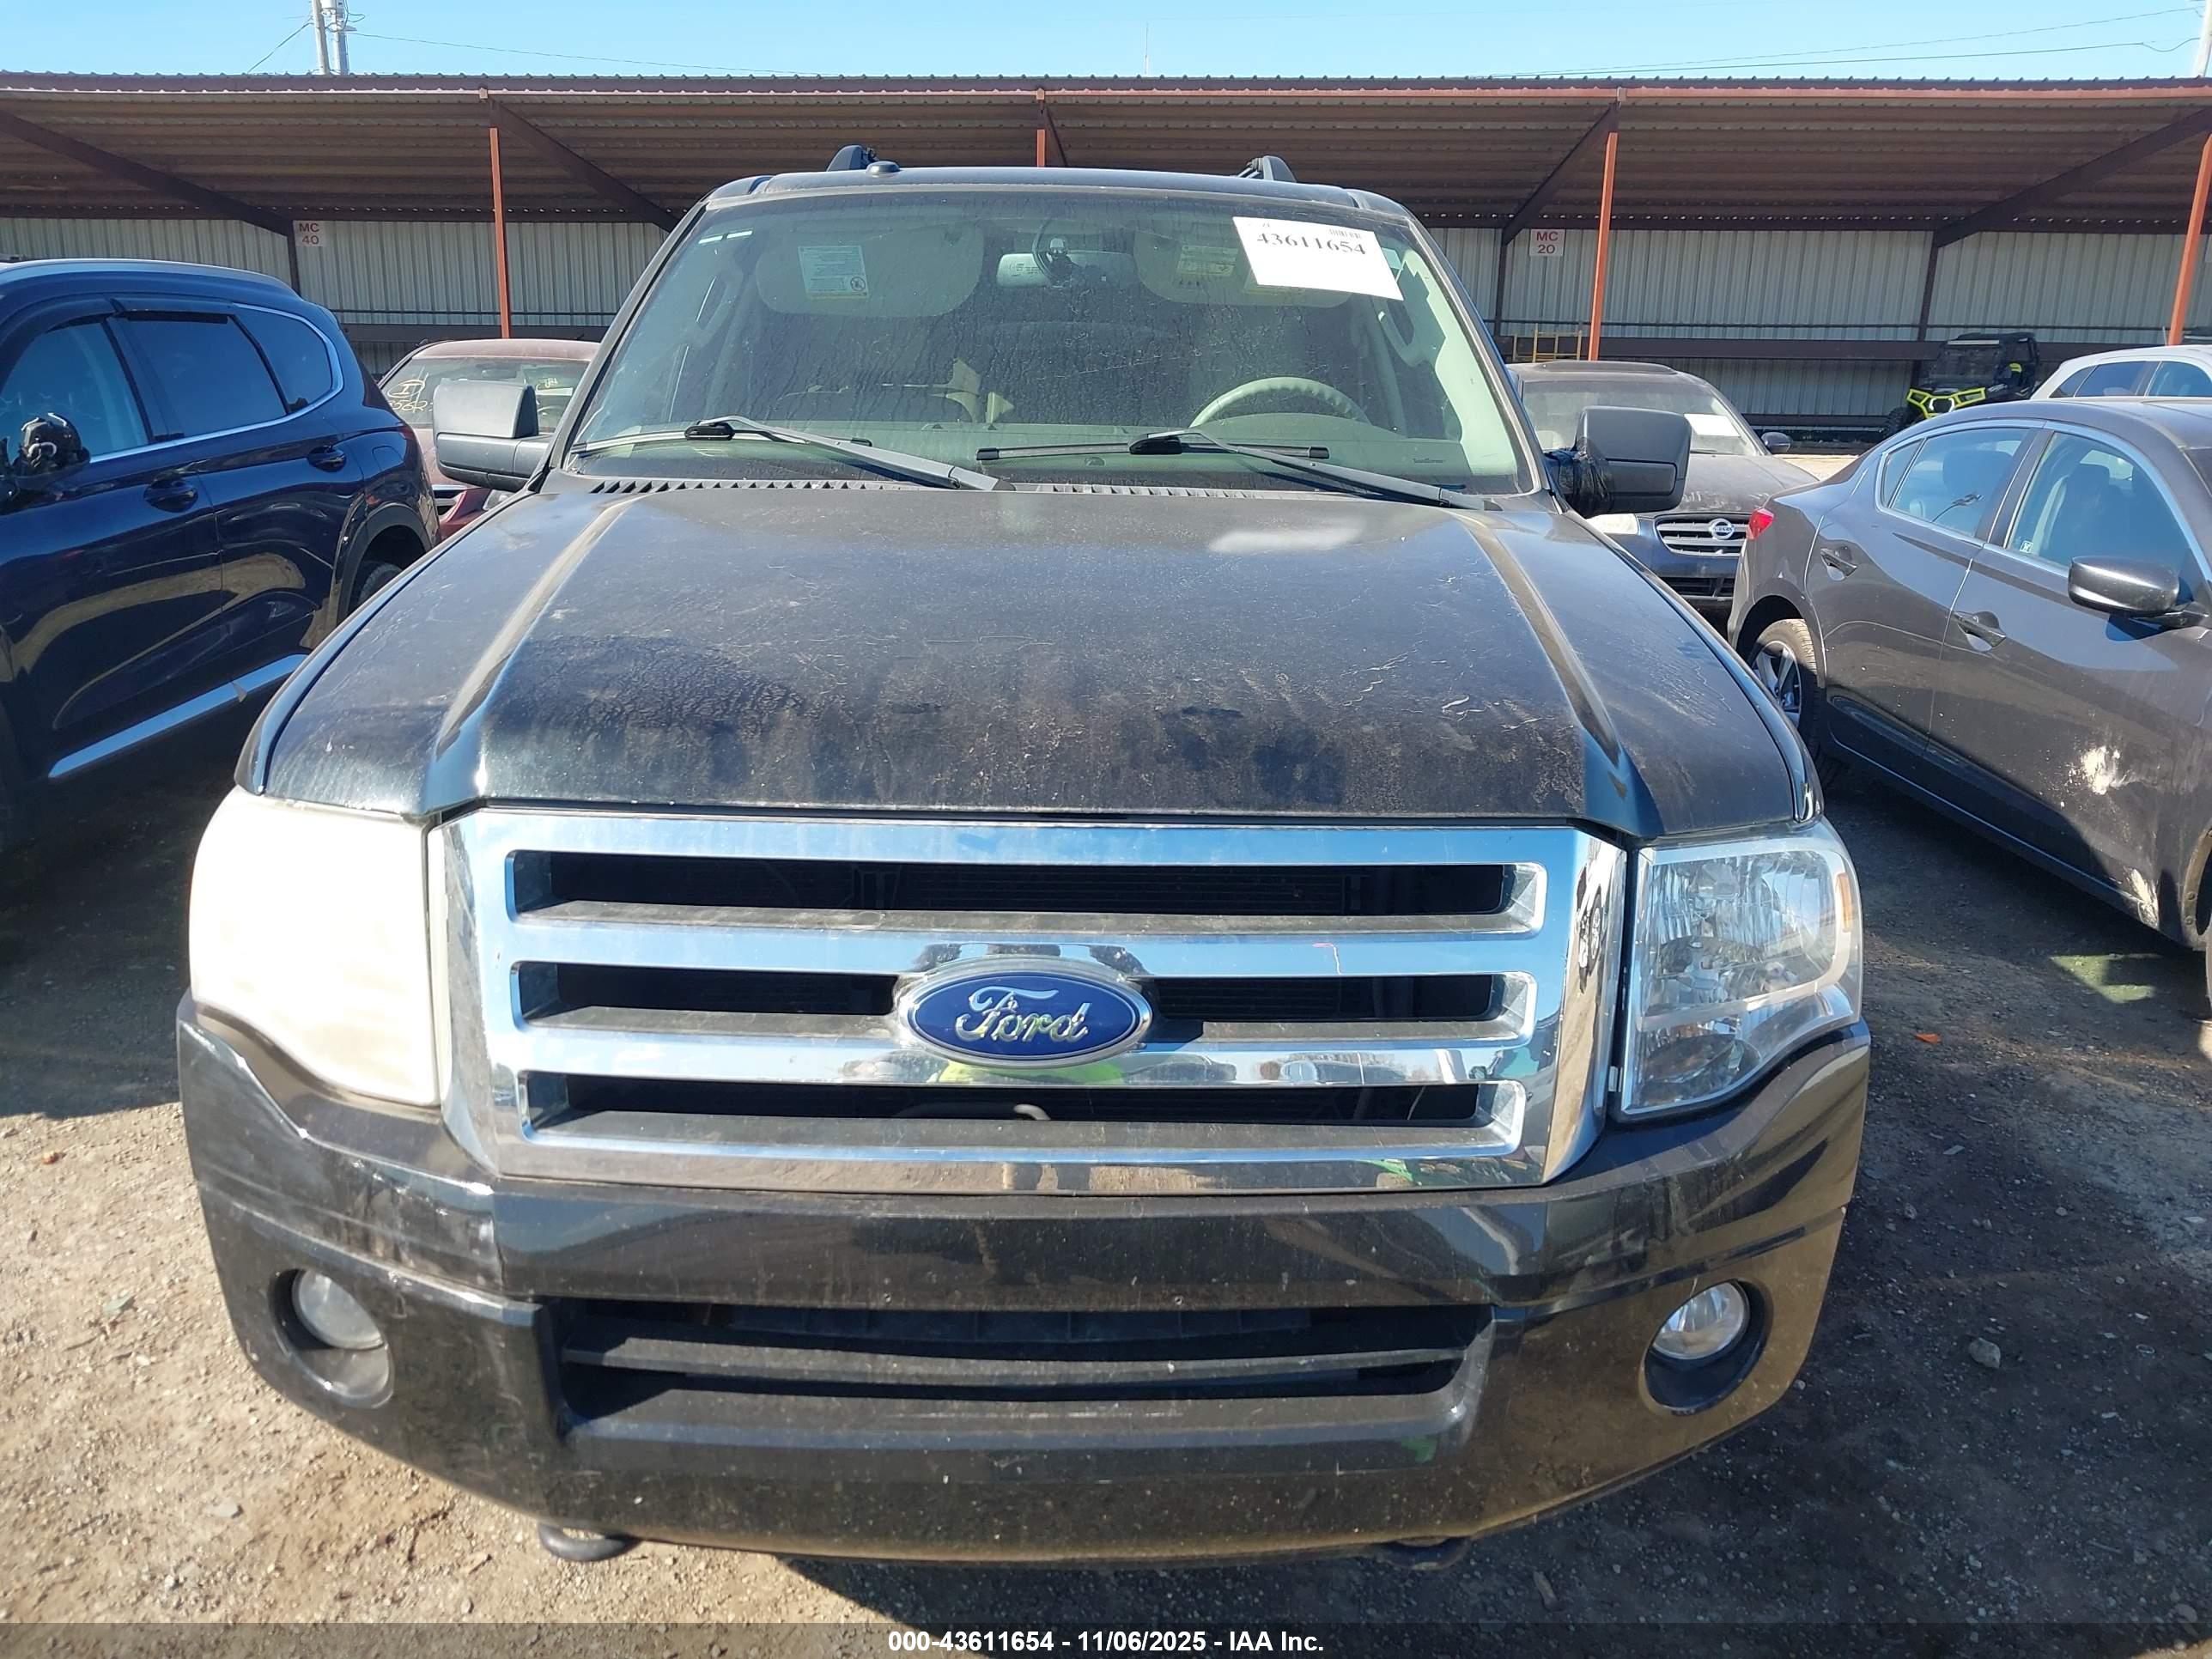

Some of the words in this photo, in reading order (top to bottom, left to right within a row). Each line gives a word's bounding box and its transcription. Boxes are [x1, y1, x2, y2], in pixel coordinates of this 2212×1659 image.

[299, 222, 319, 233] MC
[302, 235, 319, 245] 40
[1536, 231, 1559, 241] MC
[1256, 233, 1366, 255] 43611654
[1537, 244, 1556, 254] 20
[955, 986, 1092, 1042] Ford
